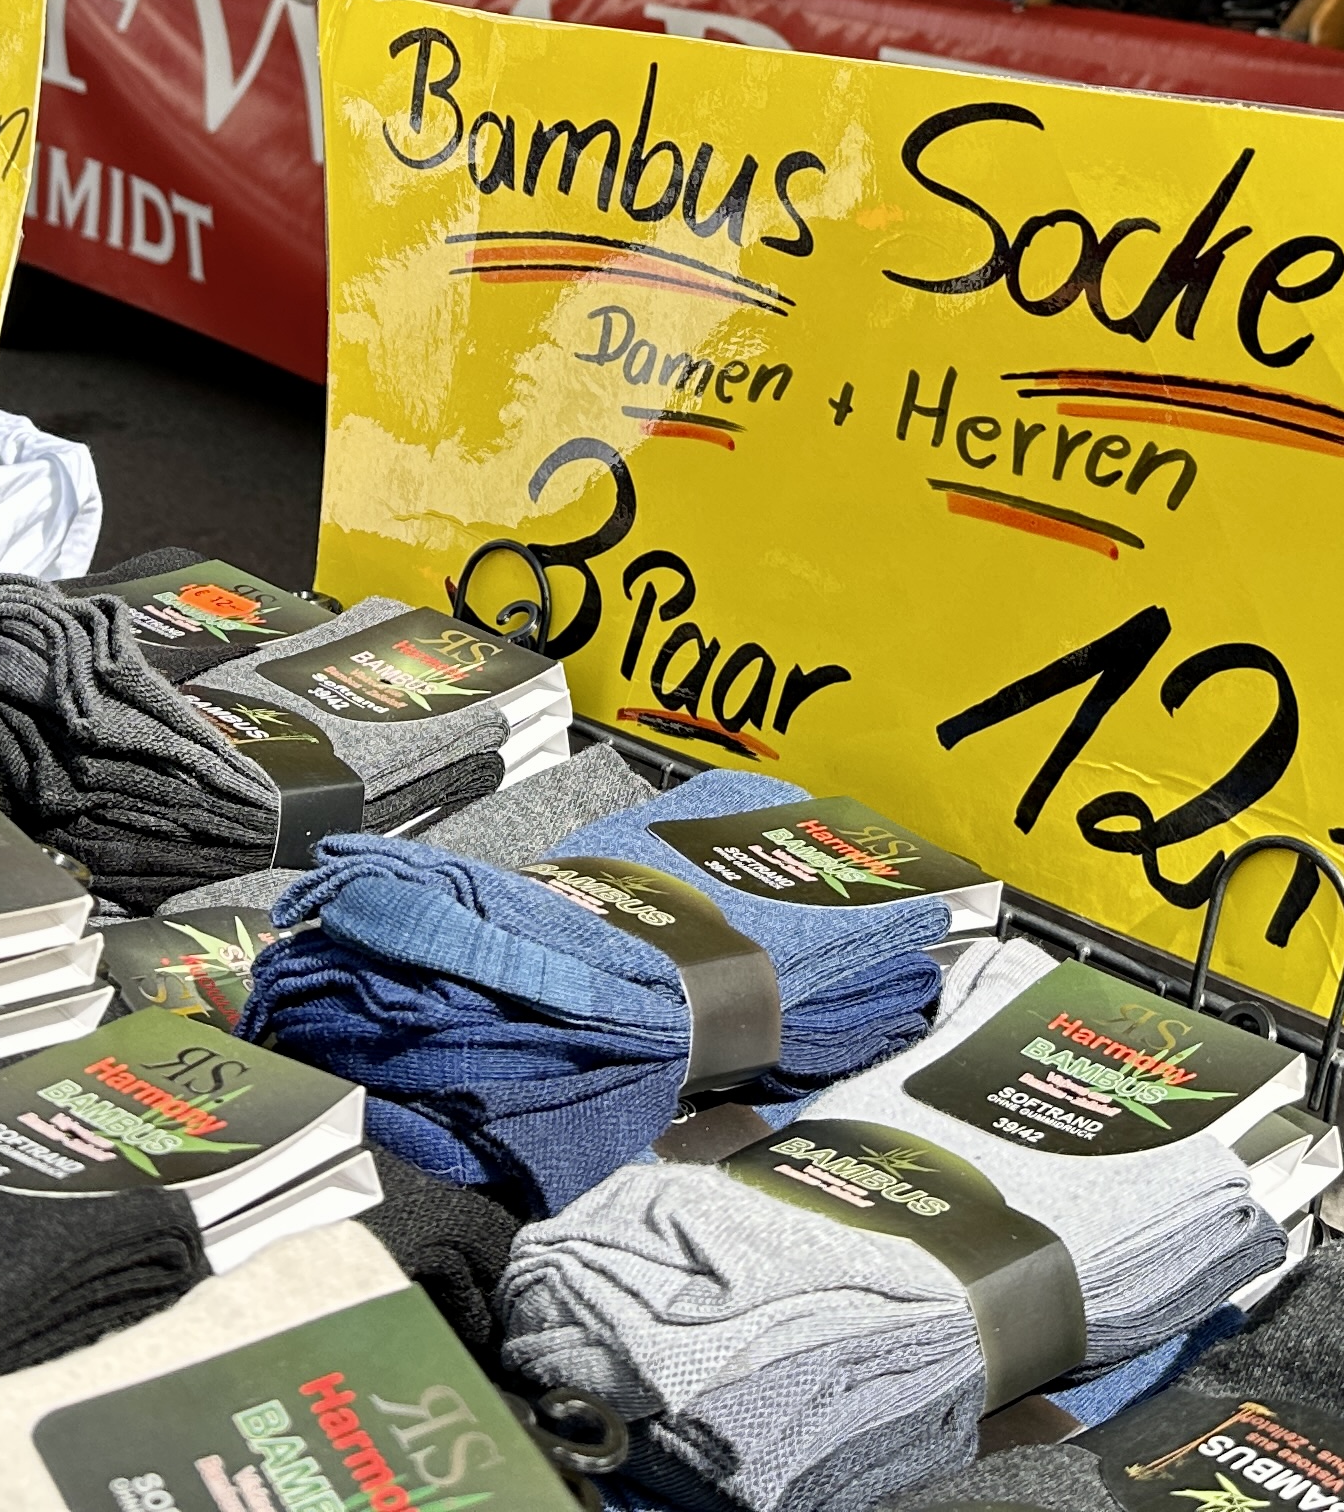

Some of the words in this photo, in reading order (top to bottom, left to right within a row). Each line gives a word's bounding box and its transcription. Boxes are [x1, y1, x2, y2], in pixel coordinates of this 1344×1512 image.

[382, 26, 828, 260] Bambus
[25, 138, 214, 284] MIDT
[575, 305, 793, 405] Damen
[827, 395, 855, 427] +
[896, 366, 1198, 512] Herren
[446, 437, 638, 656] 3
[623, 550, 851, 736] Paar
[307, 686, 352, 712] 39/42
[311, 671, 391, 715] Softrand
[349, 650, 439, 696] BAMBUS
[723, 845, 796, 888] SOFTRAND
[761, 828, 868, 883] BAMBUS
[796, 819, 901, 876] Harmony
[518, 863, 677, 928] BAMBUS
[1020, 1036, 1169, 1105] BAMBUS
[1047, 1010, 1198, 1086] Harmony
[36, 1078, 184, 1156] BAMBUS
[83, 1055, 229, 1137] Harmony
[986, 1093, 1022, 1115] OHNE
[997, 1086, 1104, 1133] SOFTRAND
[991, 1117, 1046, 1143] 39/42
[768, 1136, 952, 1217] BAMBUS
[299, 1370, 422, 1512] Harmo
